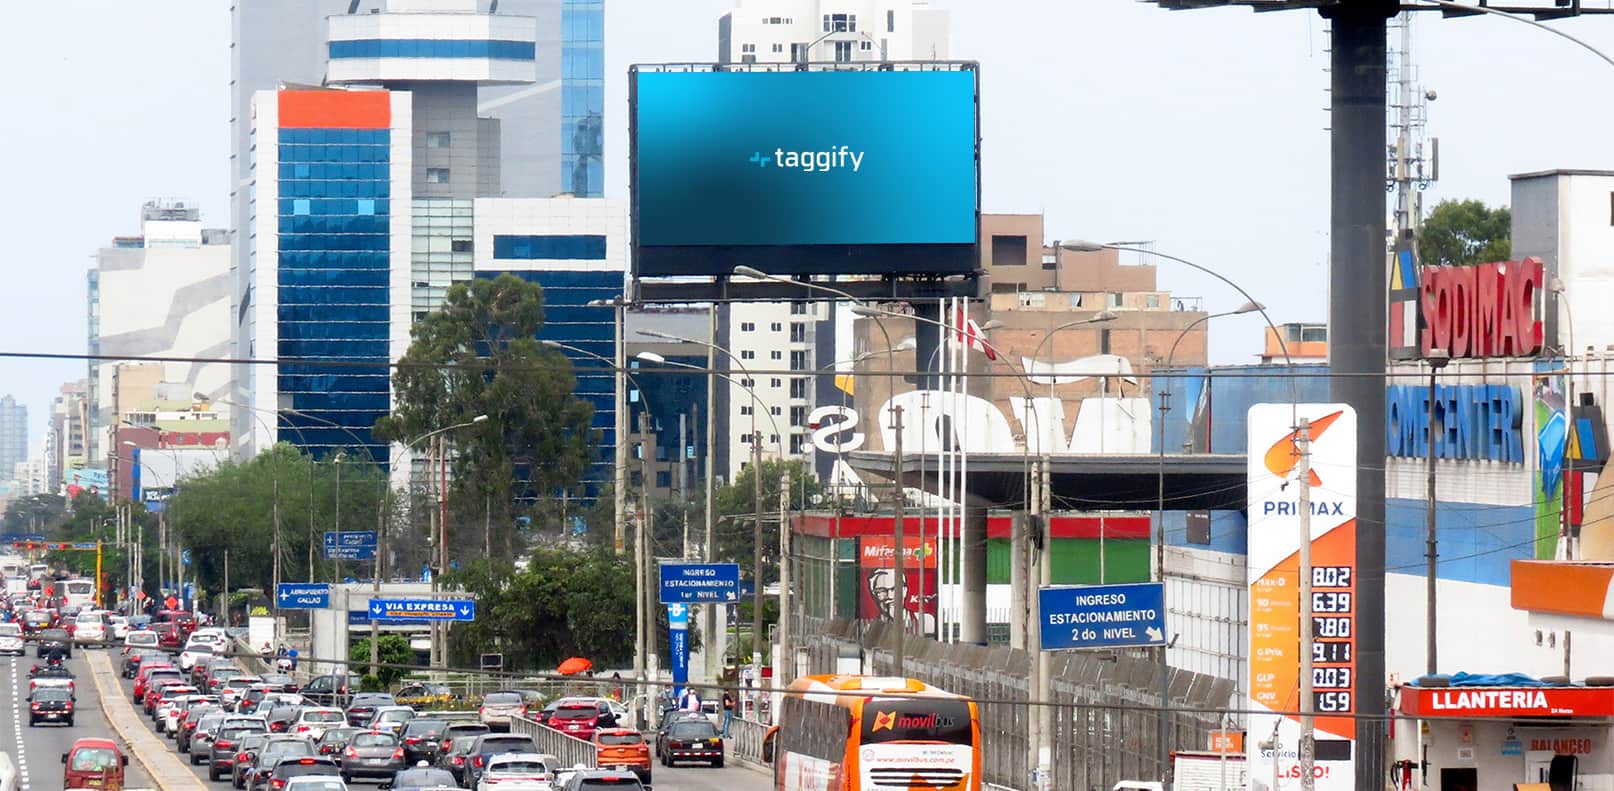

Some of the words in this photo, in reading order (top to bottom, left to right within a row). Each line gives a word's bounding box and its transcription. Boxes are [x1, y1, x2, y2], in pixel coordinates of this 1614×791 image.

[775, 145, 864, 172] taggify
[1421, 256, 1544, 358] SODIMAC
[1384, 383, 1525, 465] OMECENTER
[683, 569, 716, 577] INGRESO
[664, 580, 735, 588] ESTACIONAMIENTO
[697, 591, 719, 599] NIVEL
[1075, 593, 1126, 607] INGRESO
[385, 602, 404, 611] VIA
[406, 602, 455, 612] EXPRESA
[1049, 609, 1156, 625] ESTACIONAMIENTO
[1072, 628, 1079, 641] 2
[1082, 628, 1097, 640] do
[1103, 627, 1137, 640] NIVEL
[1432, 691, 1549, 710] LLANTERIA
[898, 712, 956, 729] movilbus
